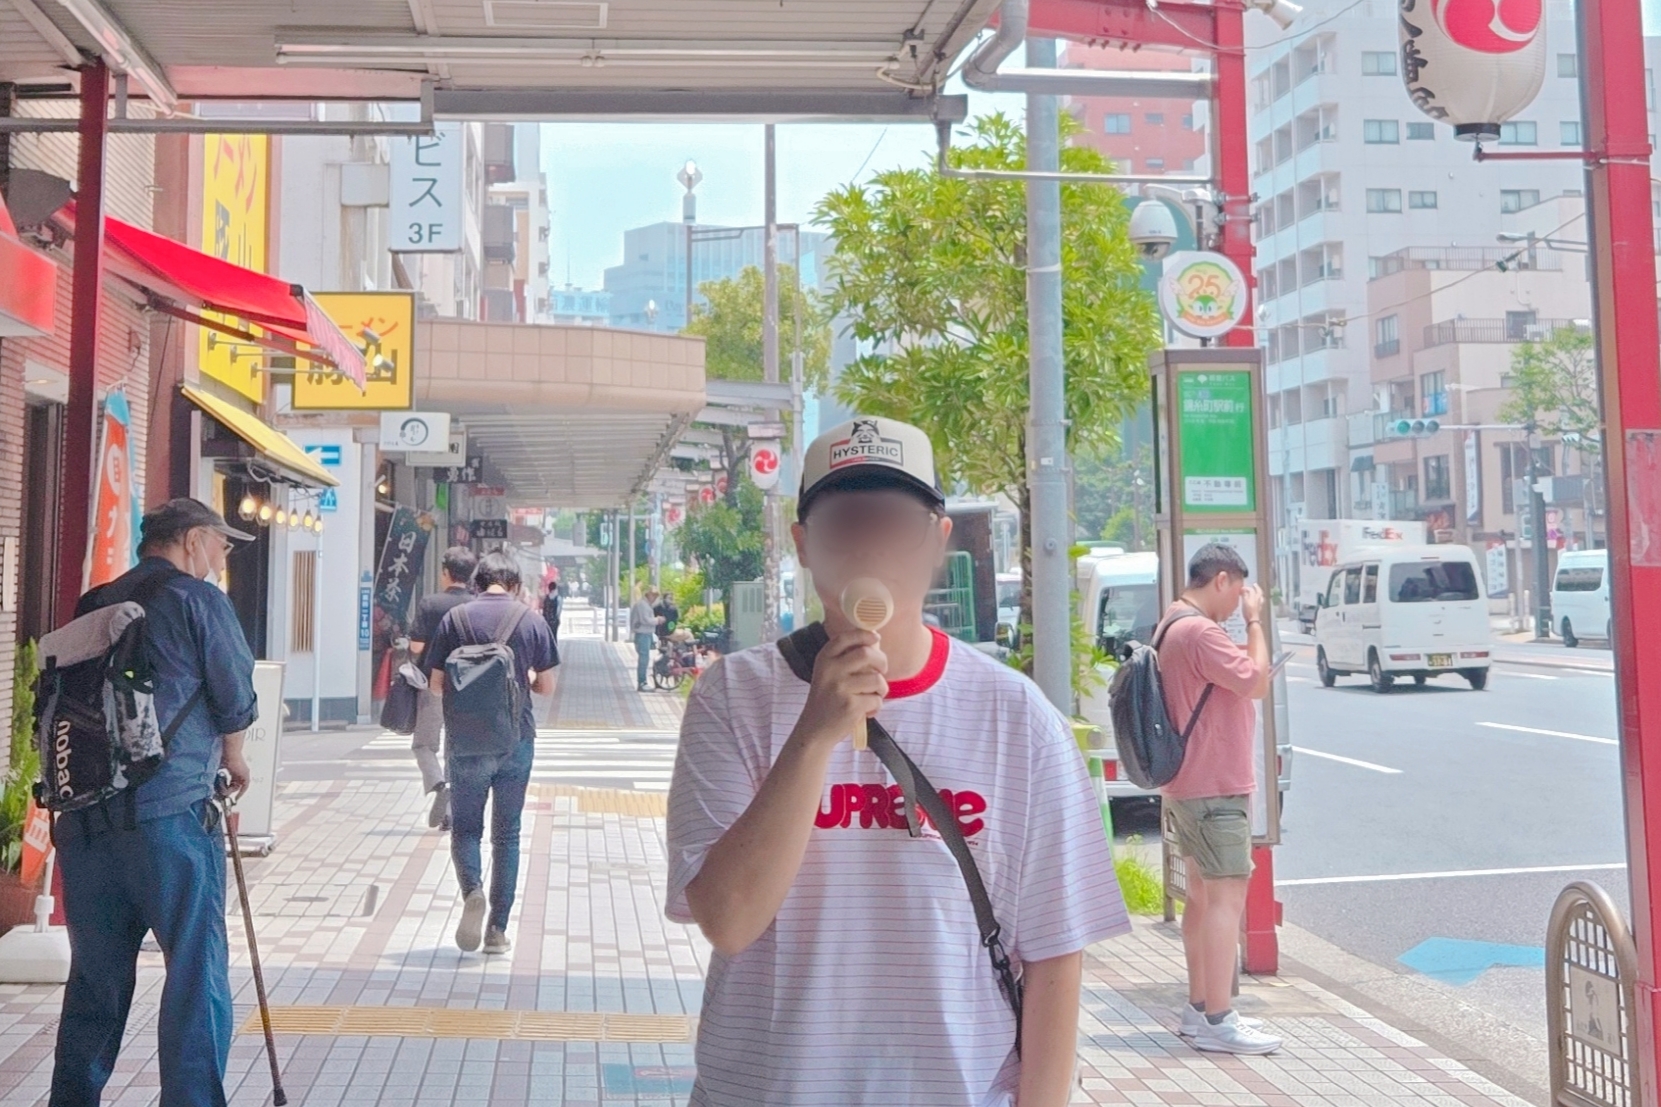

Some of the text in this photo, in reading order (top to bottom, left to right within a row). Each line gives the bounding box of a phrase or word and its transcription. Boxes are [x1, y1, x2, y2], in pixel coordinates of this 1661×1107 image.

[408, 222, 443, 244] 3F
[1188, 274, 1222, 300] 25
[833, 445, 899, 460] HYSTERIC
[1361, 527, 1403, 540] FedEx
[385, 531, 417, 603] 日本茶
